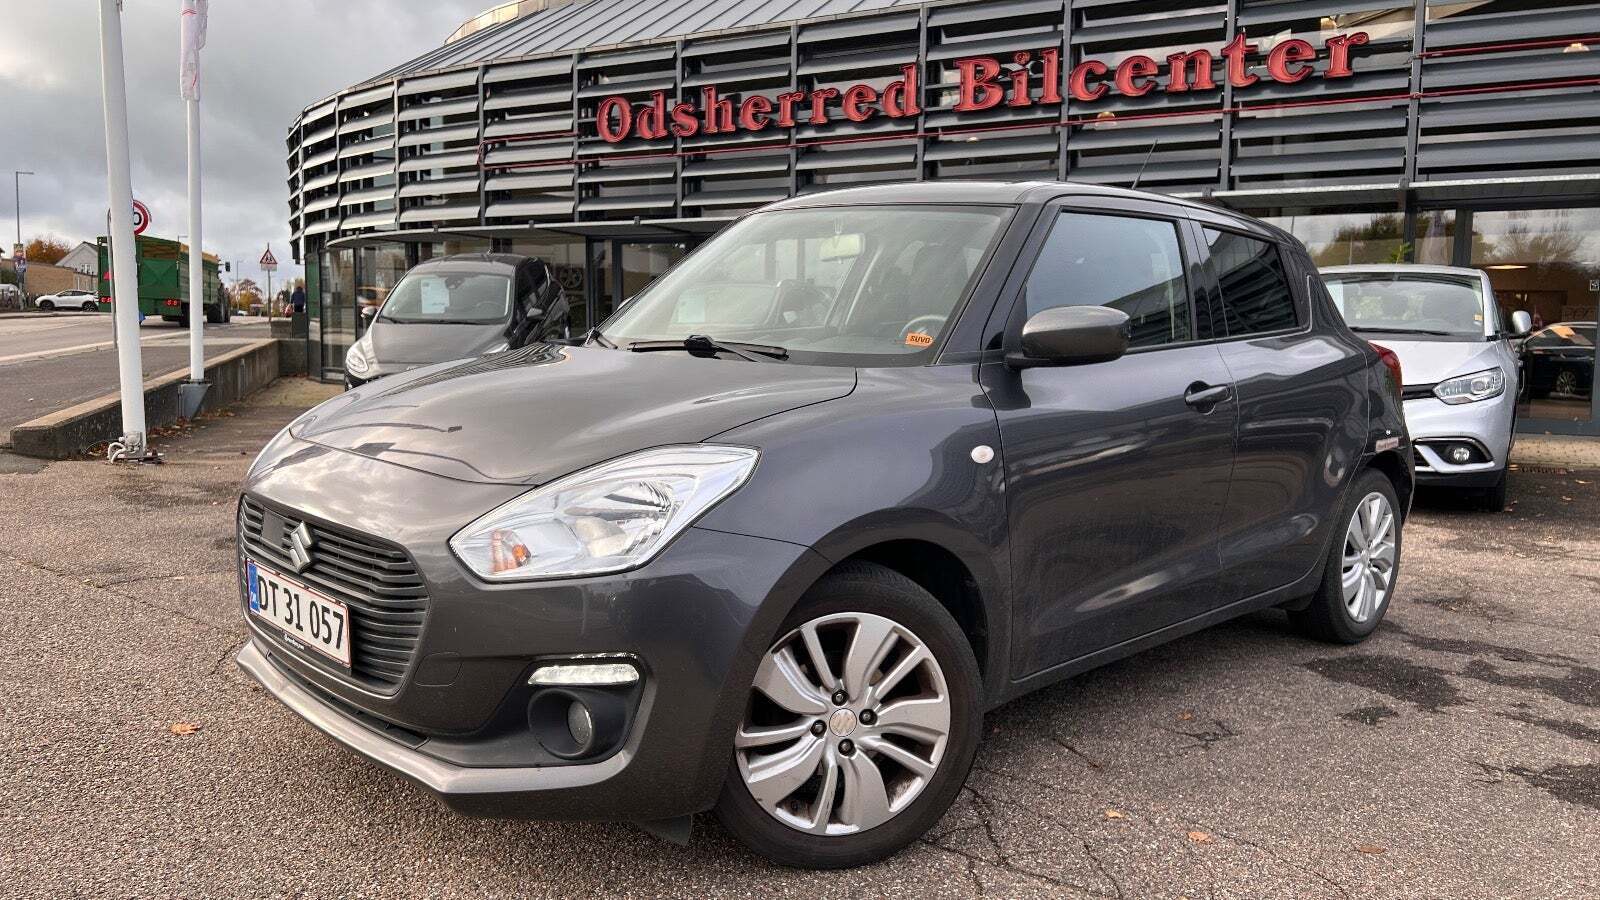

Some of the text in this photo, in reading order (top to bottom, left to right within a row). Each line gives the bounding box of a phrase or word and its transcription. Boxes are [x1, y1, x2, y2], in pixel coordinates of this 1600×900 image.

[596, 31, 1370, 141] Odsherred Bilcenter
[257, 575, 344, 650] DT 31 057
